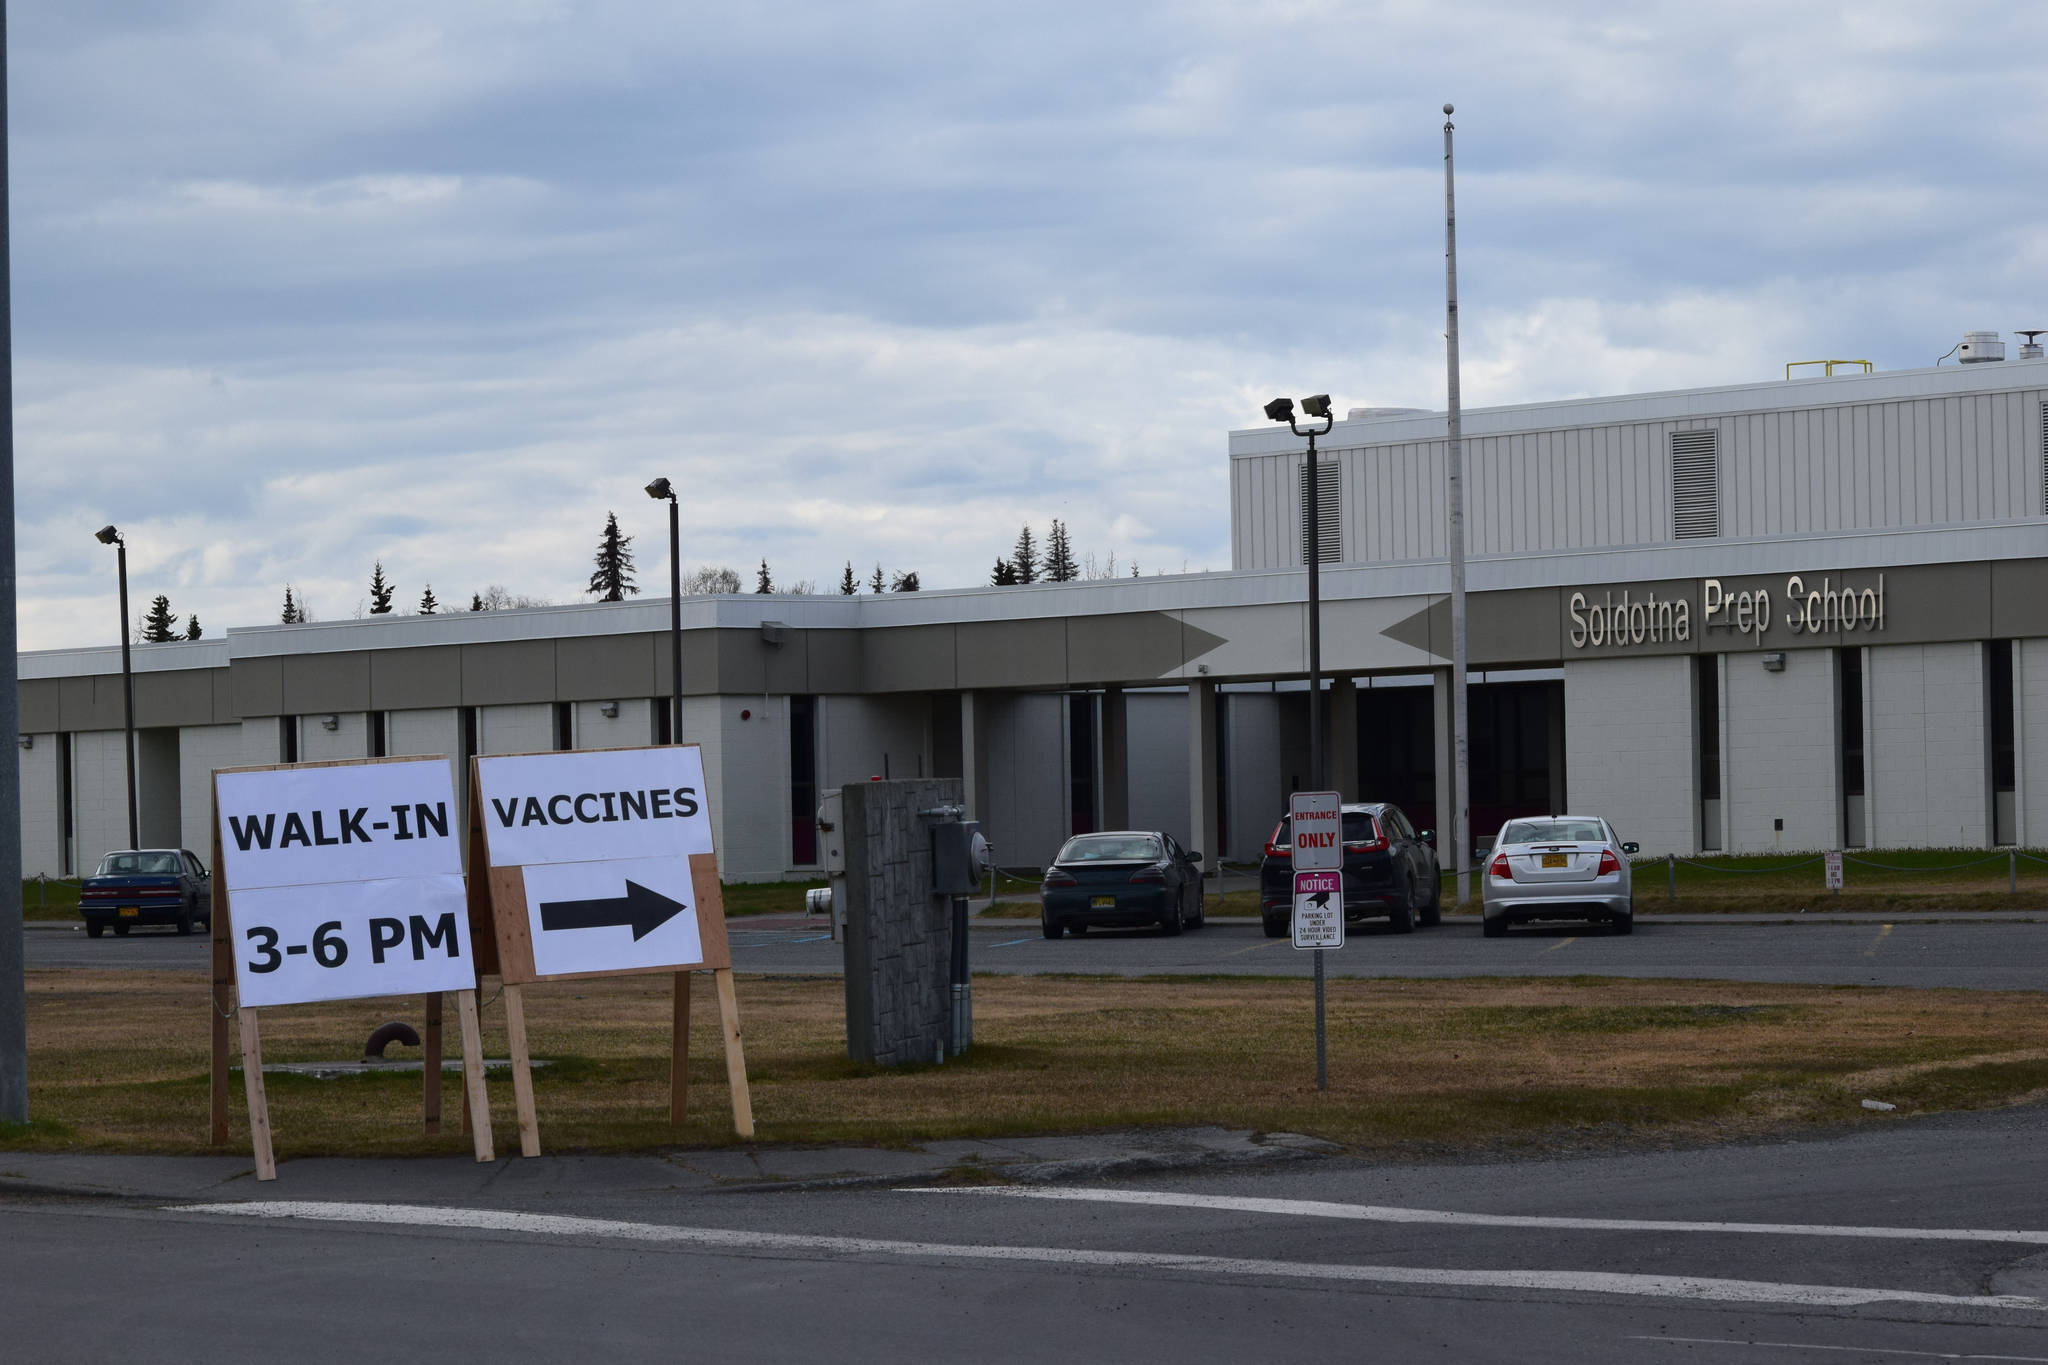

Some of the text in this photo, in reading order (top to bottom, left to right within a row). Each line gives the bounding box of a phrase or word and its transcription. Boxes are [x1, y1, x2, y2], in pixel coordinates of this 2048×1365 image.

[1570, 573, 1884, 648] Soldotna Prep School
[491, 786, 699, 828] VACCINES
[1295, 811, 1337, 821] ENTRANCE
[227, 801, 450, 852] WALK-IN
[1298, 832, 1336, 848] ONLY
[1300, 879, 1334, 891] NOTICE
[246, 912, 461, 974] 3-6 PM
[1300, 933, 1336, 941] SURVEILLANCE
